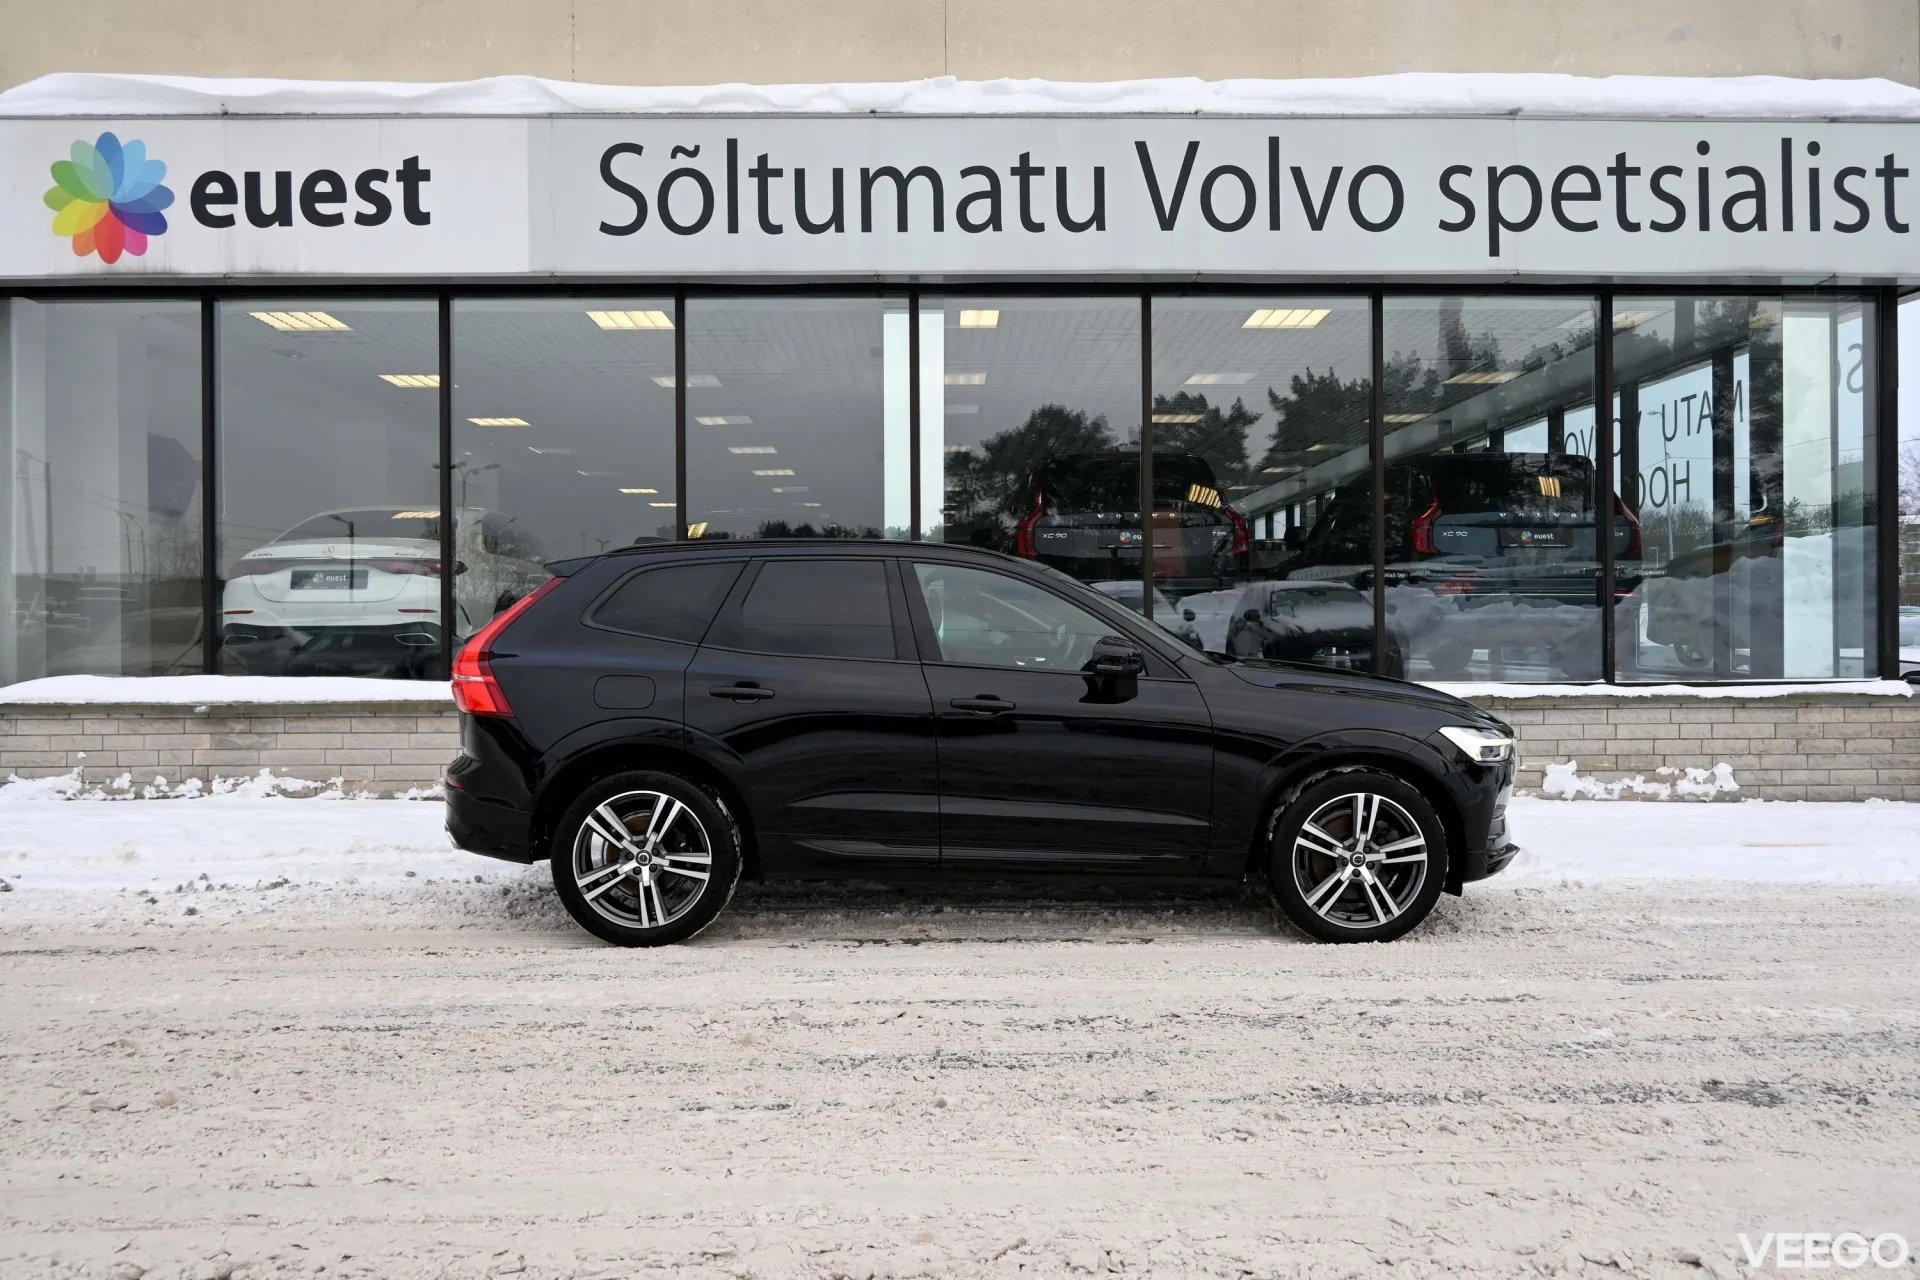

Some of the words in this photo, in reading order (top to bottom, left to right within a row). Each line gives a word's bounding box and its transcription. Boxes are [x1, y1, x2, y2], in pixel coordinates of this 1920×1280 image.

[190, 156, 431, 229] euest
[599, 138, 1106, 236] Sõltumatu
[1135, 136, 1405, 233] Volvo
[1439, 138, 1910, 258] spetsialist
[1534, 532, 1554, 540] euest
[326, 574, 347, 582] euest
